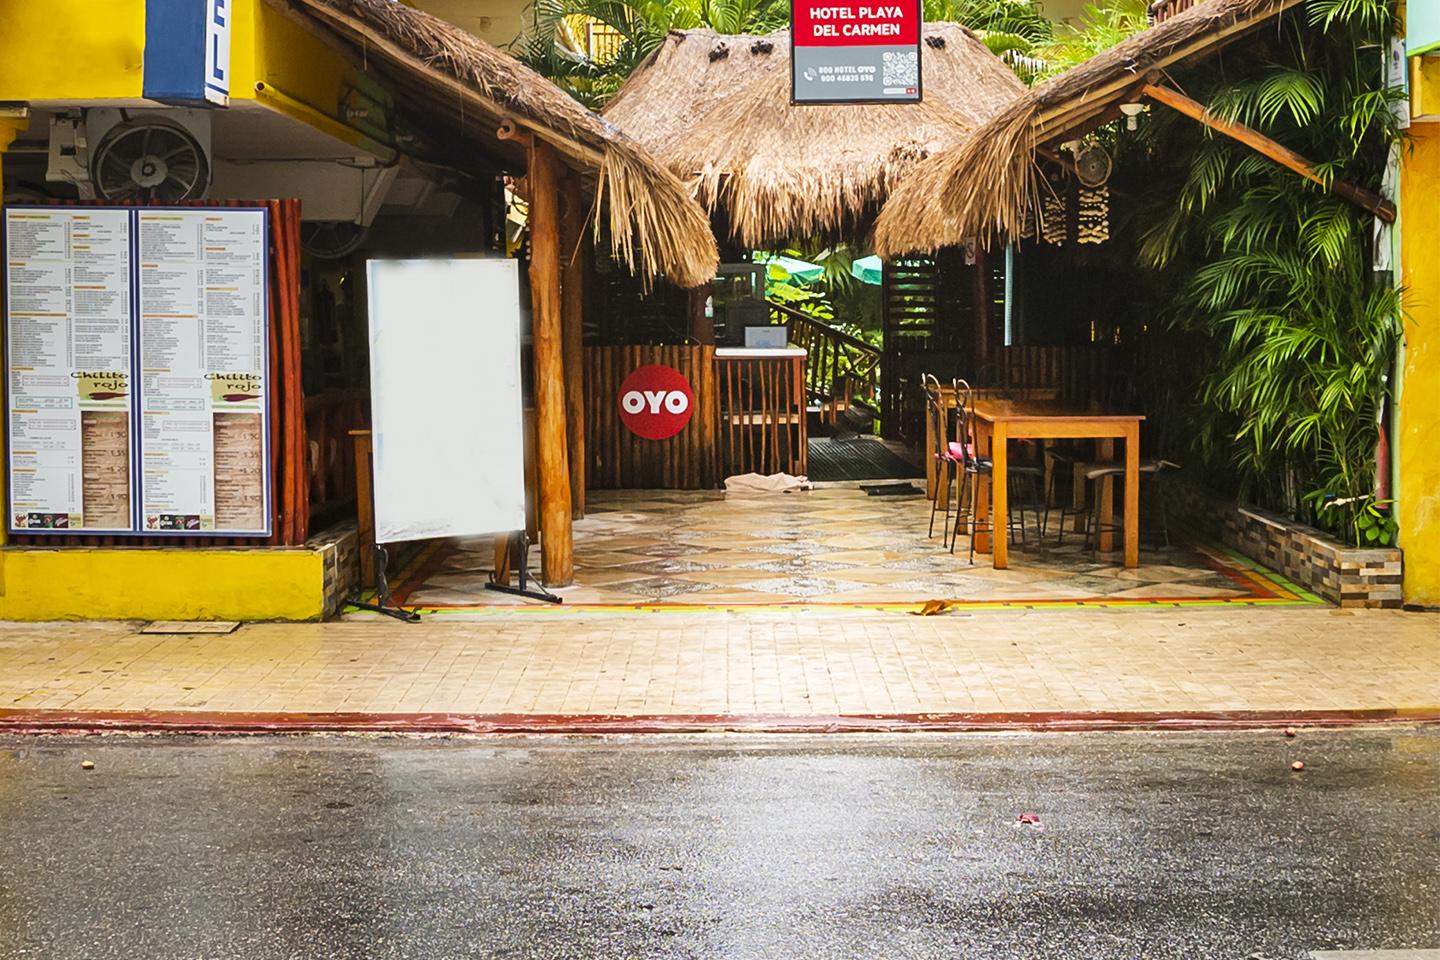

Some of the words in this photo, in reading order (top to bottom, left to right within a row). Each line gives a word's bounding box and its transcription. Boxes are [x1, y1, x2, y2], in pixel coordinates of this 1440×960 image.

[809, 7, 856, 20] HOTEL
[859, 6, 904, 19] PLAYA
[813, 24, 840, 37] DEL
[842, 23, 900, 36] CARMEN
[857, 65, 876, 74] OYO
[93, 380, 128, 390] rojo
[227, 381, 261, 392] rojo
[622, 390, 688, 414] OYO
